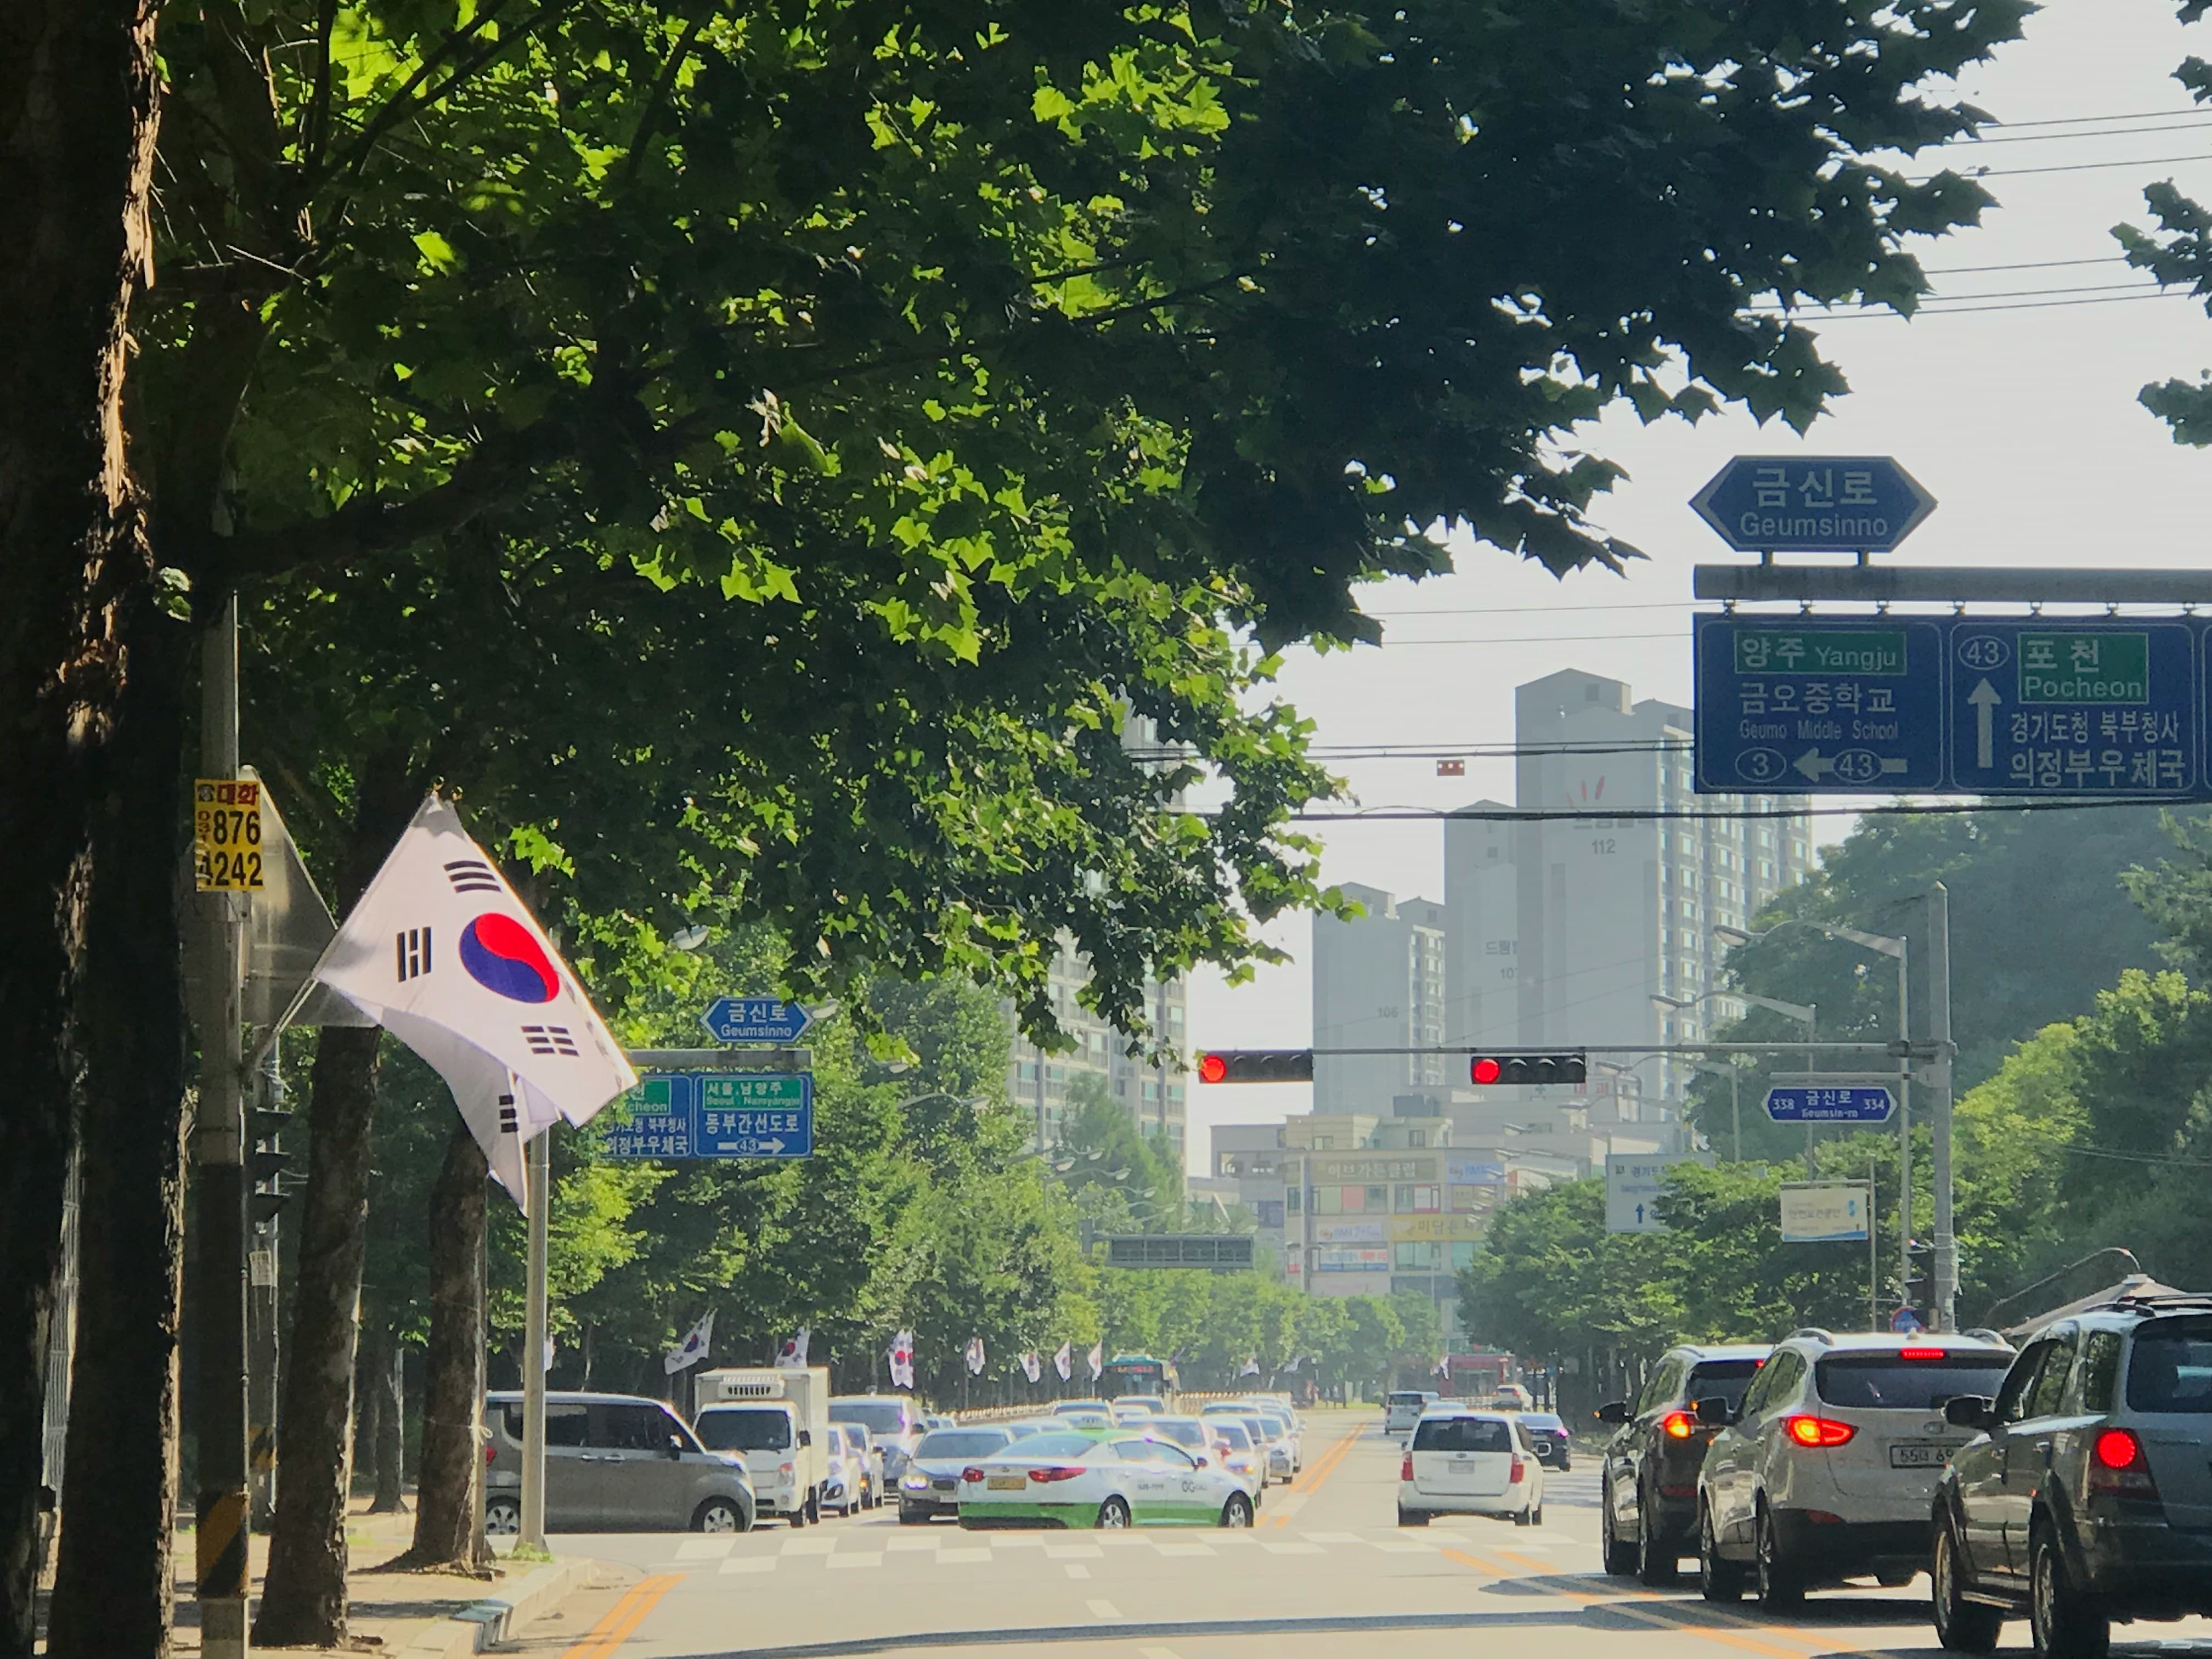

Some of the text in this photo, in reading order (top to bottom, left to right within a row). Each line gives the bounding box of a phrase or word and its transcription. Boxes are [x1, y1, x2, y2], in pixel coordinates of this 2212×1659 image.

[1752, 467, 1878, 508] 금신로
[1740, 511, 1888, 537] Geumsinno
[1742, 636, 1897, 671] 양주 Yangju
[1966, 640, 1999, 664] 43
[2025, 676, 2141, 697] Pocheon
[1739, 681, 1896, 715] 금오중학교
[1739, 719, 1899, 739] Geumo Middle School
[2011, 711, 2180, 743] 경기도청 북부청사
[1752, 752, 1768, 776] 3
[1839, 753, 1872, 777] 43
[2010, 748, 2186, 788] 의정부우체국
[217, 783, 259, 805] 대화
[213, 810, 261, 845] 876
[1592, 839, 1616, 854] 112
[1500, 967, 1518, 979] 10
[728, 1002, 788, 1023] 금신로
[721, 1023, 792, 1037] Geumsinno
[628, 1102, 668, 1112] cheon
[1805, 1090, 1853, 1106] 금신로
[1864, 1098, 1885, 1110] 334
[706, 1113, 799, 1135] 동부간선도로
[1801, 1109, 1859, 1119] Geumsin-ro
[740, 1139, 757, 1151] 43
